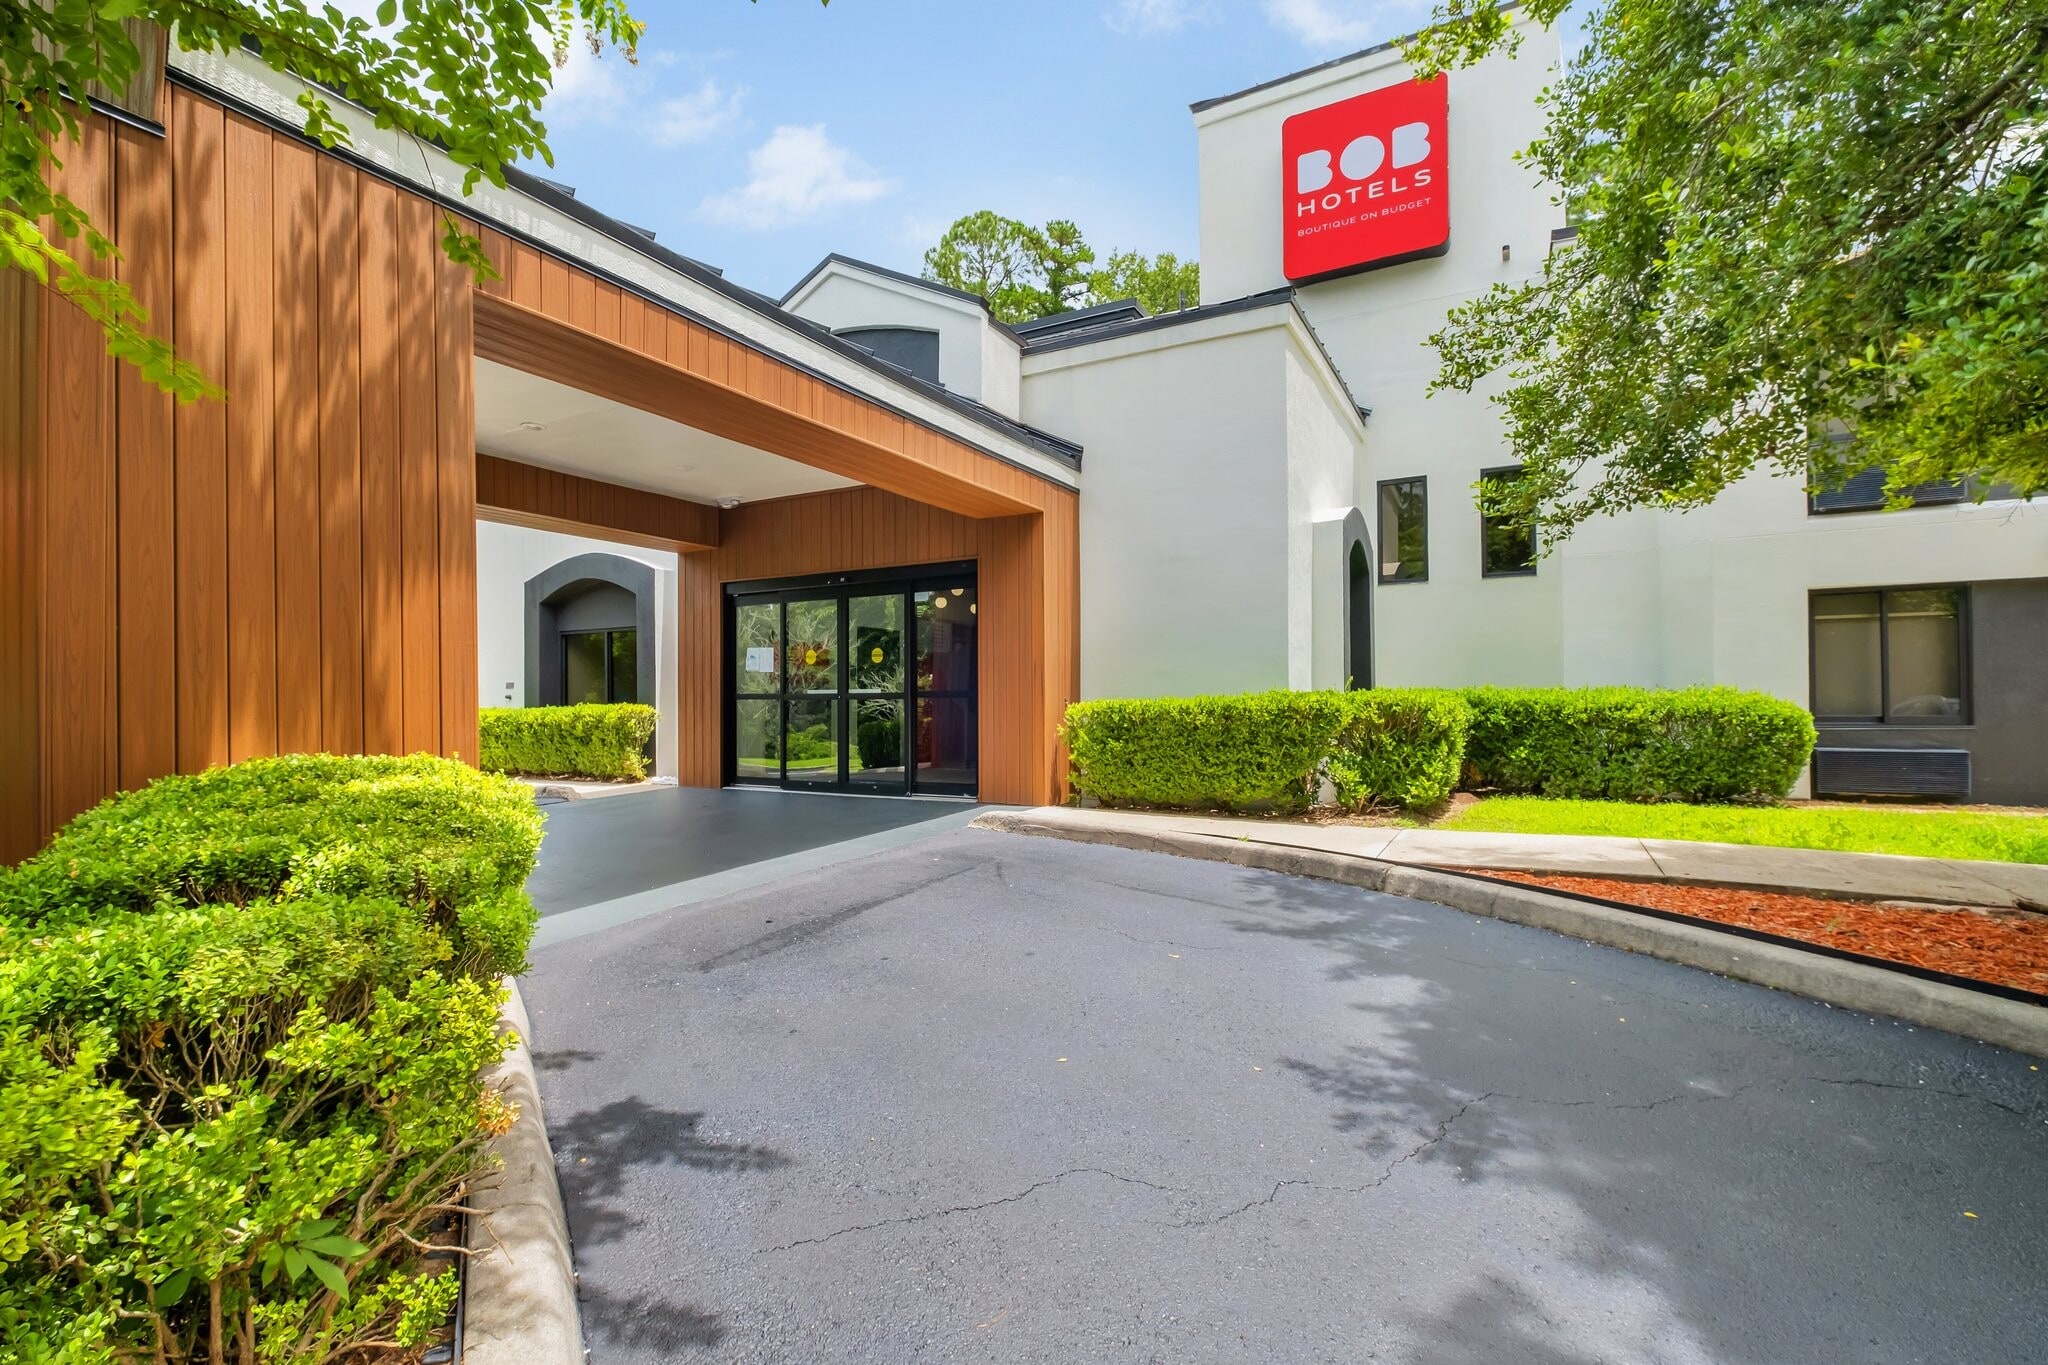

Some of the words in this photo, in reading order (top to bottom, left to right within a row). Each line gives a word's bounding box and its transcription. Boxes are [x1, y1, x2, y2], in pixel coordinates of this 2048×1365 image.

[1297, 121, 1431, 195] BOB
[1297, 168, 1432, 217] HOTELS
[1297, 216, 1357, 237] BOUTIQUE
[1360, 211, 1378, 222] ON
[1381, 198, 1432, 216] BUDGET
